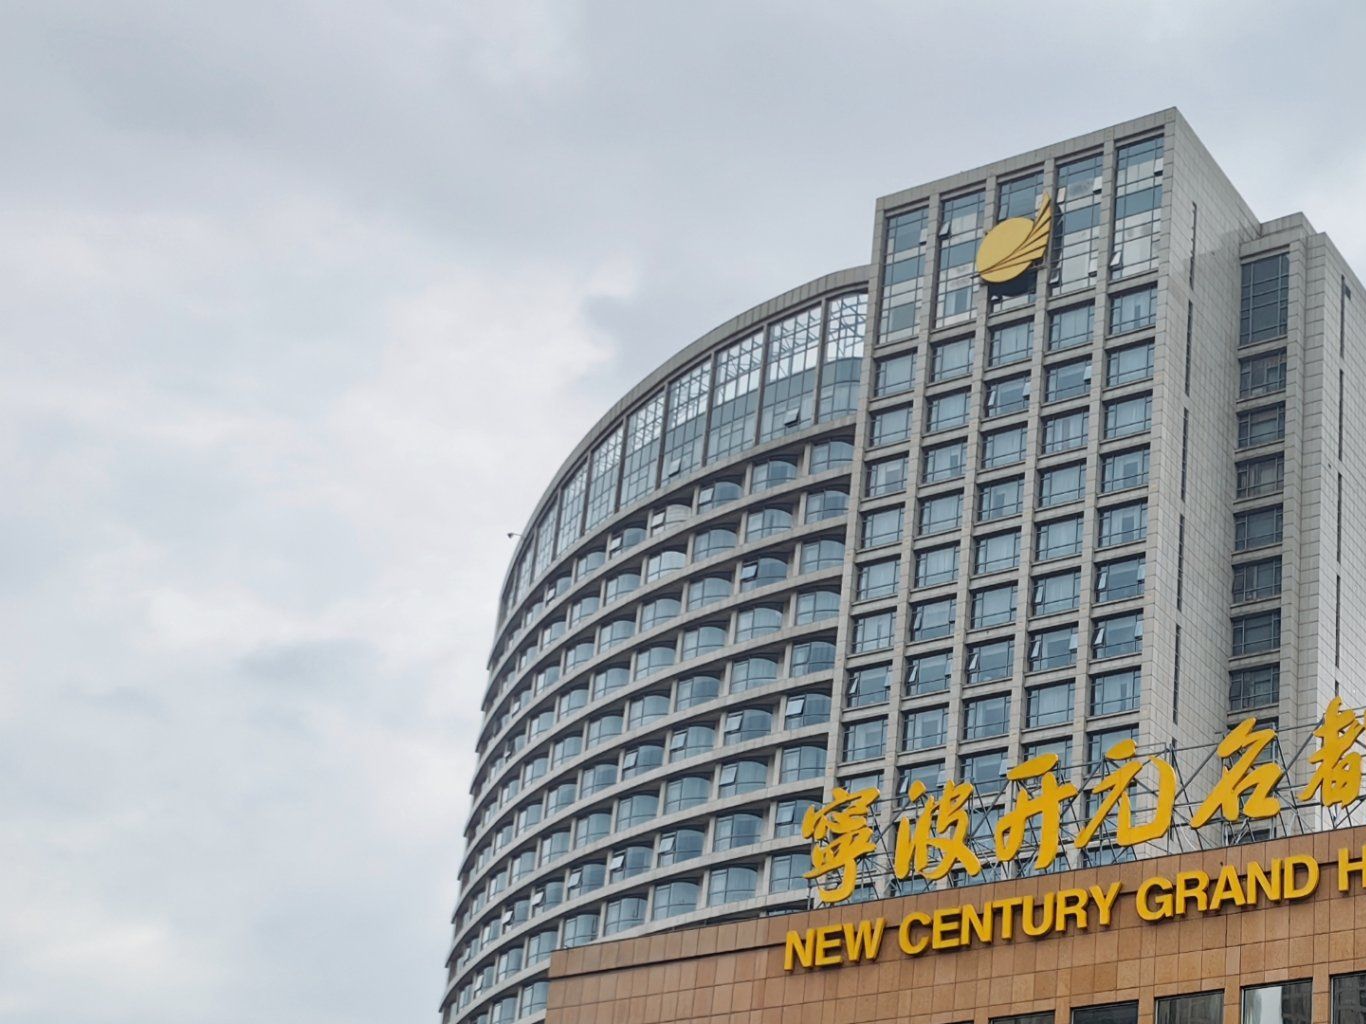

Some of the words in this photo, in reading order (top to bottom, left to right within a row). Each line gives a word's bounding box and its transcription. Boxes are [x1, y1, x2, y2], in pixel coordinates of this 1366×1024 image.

[784, 917, 886, 969] NEW
[898, 881, 1124, 955] CENTURY
[1136, 854, 1320, 921] GRAND
